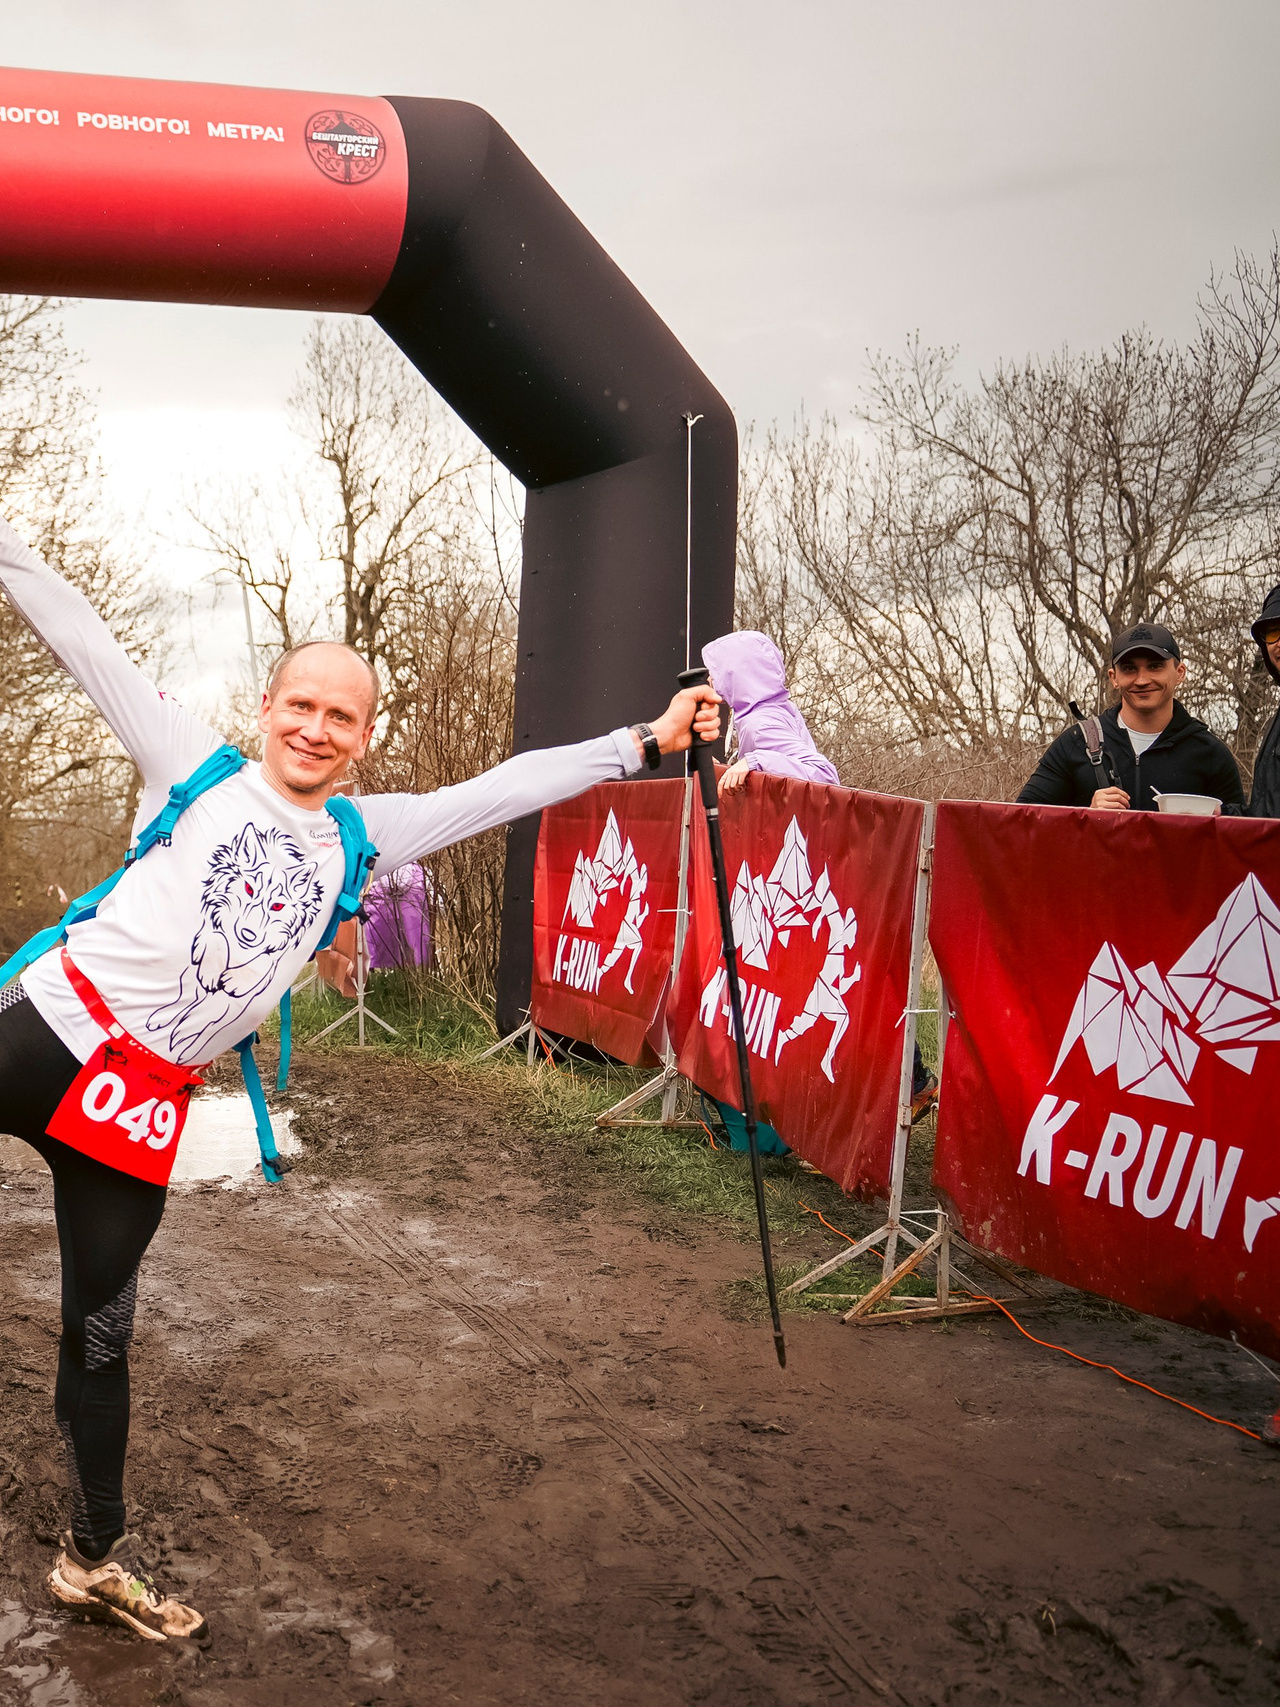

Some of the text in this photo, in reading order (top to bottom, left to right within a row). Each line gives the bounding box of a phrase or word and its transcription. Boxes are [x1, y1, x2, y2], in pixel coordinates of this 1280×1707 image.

[76, 112, 191, 135] РОВНОГО!
[206, 121, 285, 142] МЕТРА!
[337, 142, 379, 158] КРЕСТ
[552, 933, 601, 993] K-RUN
[81, 1071, 177, 1151] 049
[1016, 1093, 1244, 1240] K-RUN
